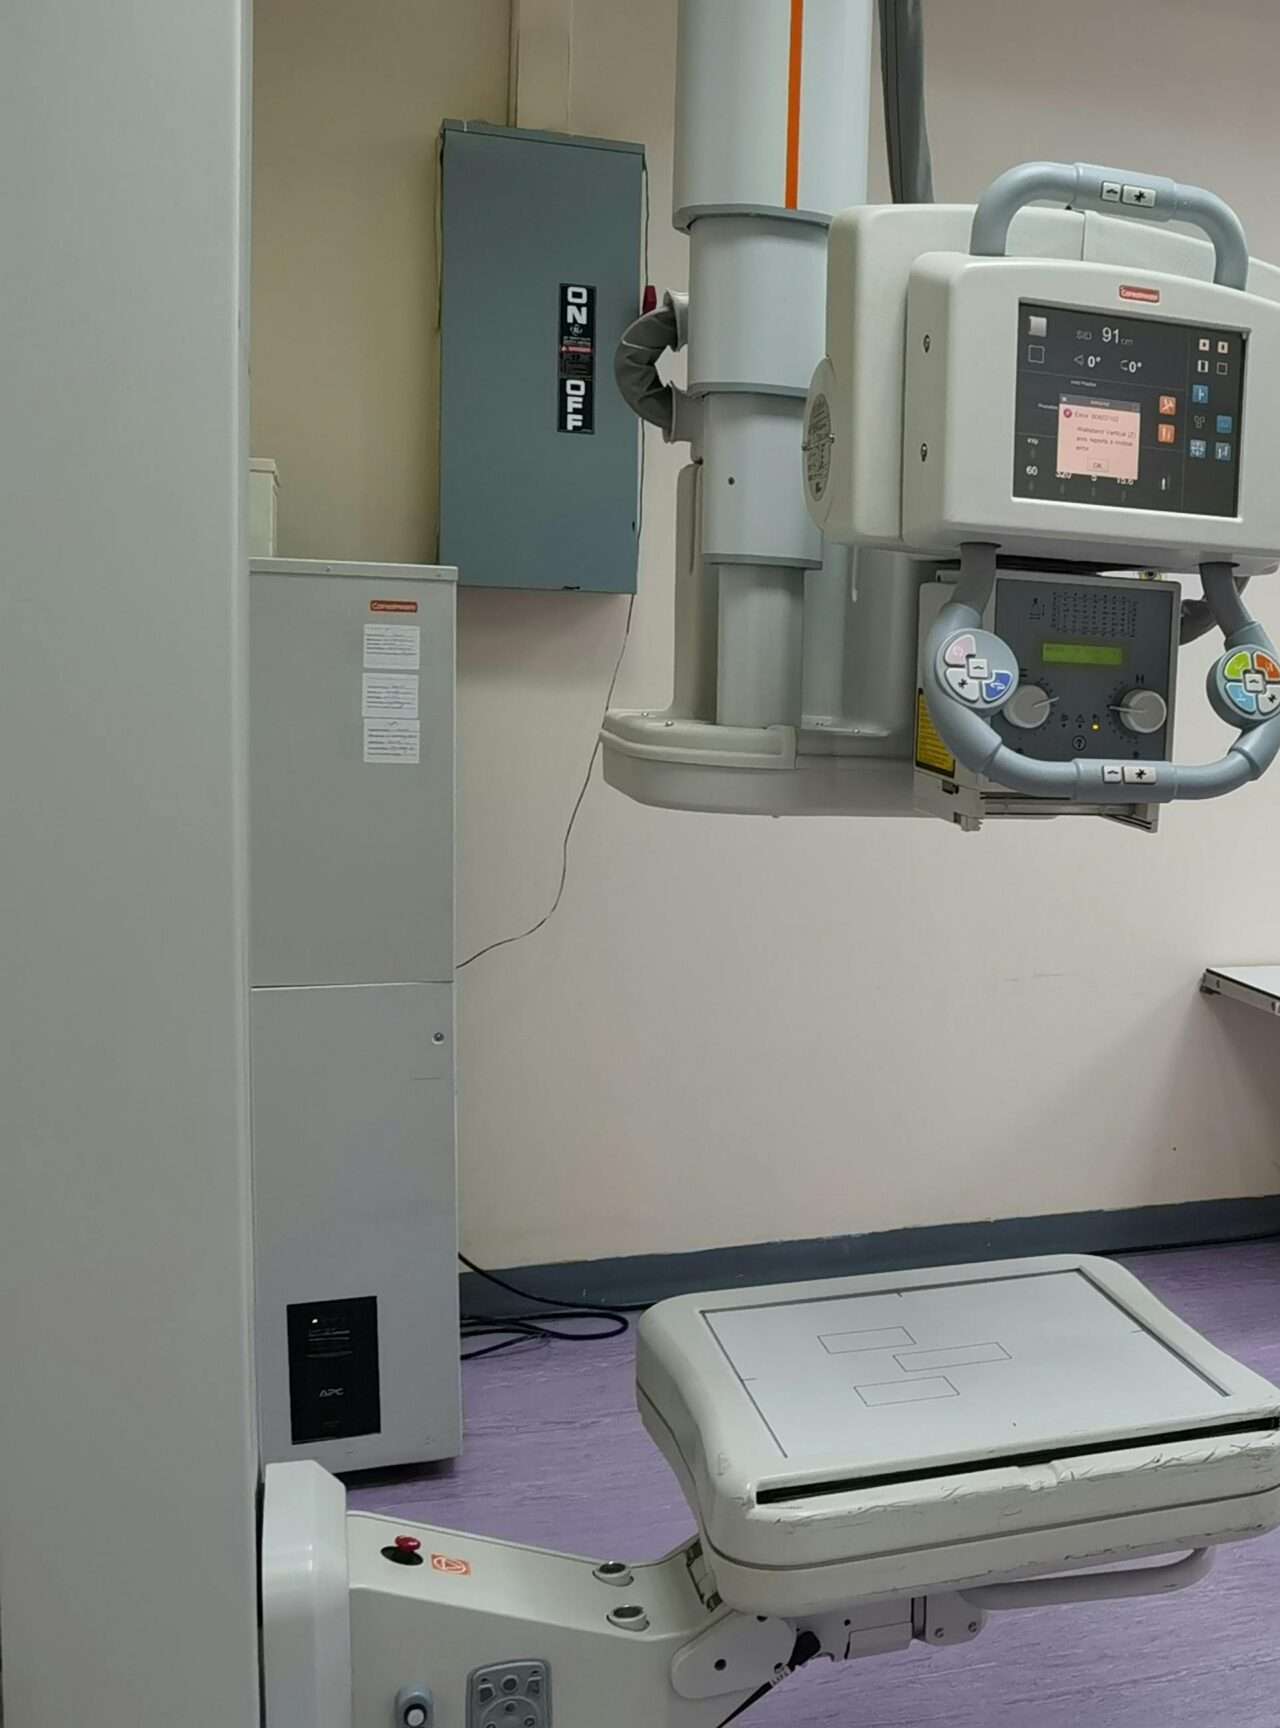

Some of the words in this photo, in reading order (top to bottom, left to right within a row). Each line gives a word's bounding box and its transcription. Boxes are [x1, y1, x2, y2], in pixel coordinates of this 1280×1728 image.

[567, 286, 588, 325] ON
[1102, 326, 1119, 344] 91
[566, 379, 586, 431] OFF
[1026, 465, 1038, 476] 60
